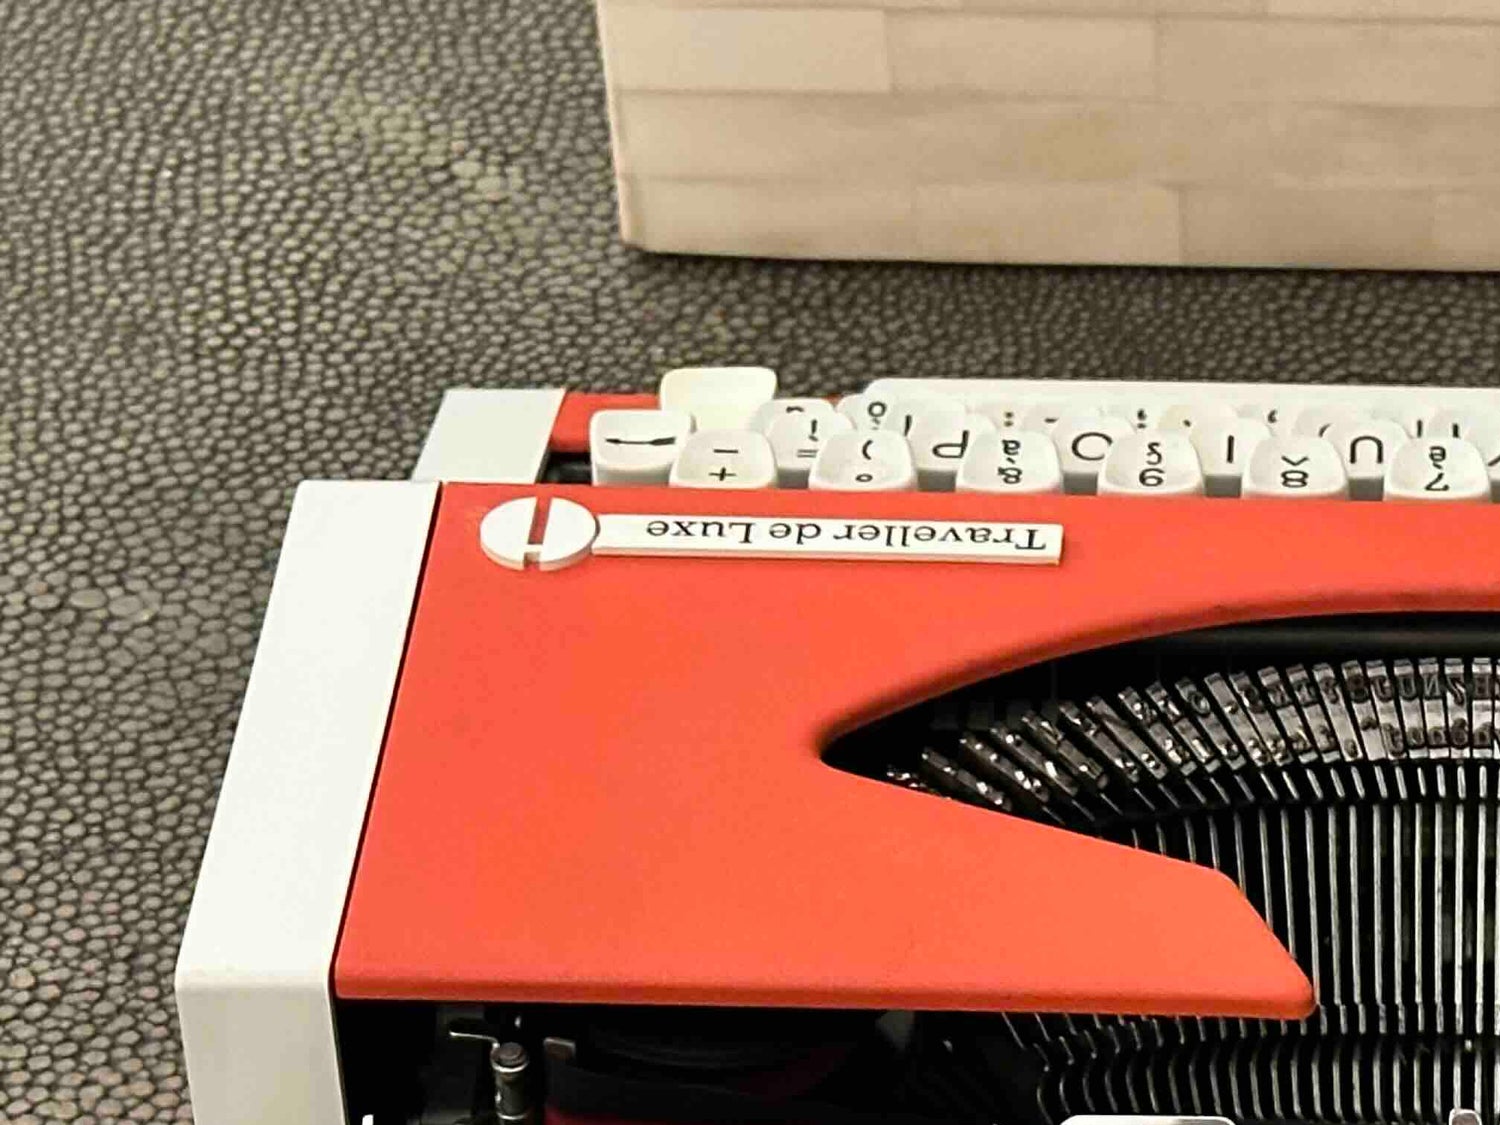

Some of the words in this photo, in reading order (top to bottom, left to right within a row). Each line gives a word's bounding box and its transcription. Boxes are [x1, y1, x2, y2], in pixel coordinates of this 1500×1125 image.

[932, 430, 970, 459] P
[1349, 435, 1384, 464] U
[1138, 468, 1164, 487] 9
[1280, 469, 1309, 488] 8
[1424, 472, 1450, 492] 7
[646, 518, 757, 544] Luxe
[769, 520, 823, 544] de
[833, 522, 1047, 551] Traveller
